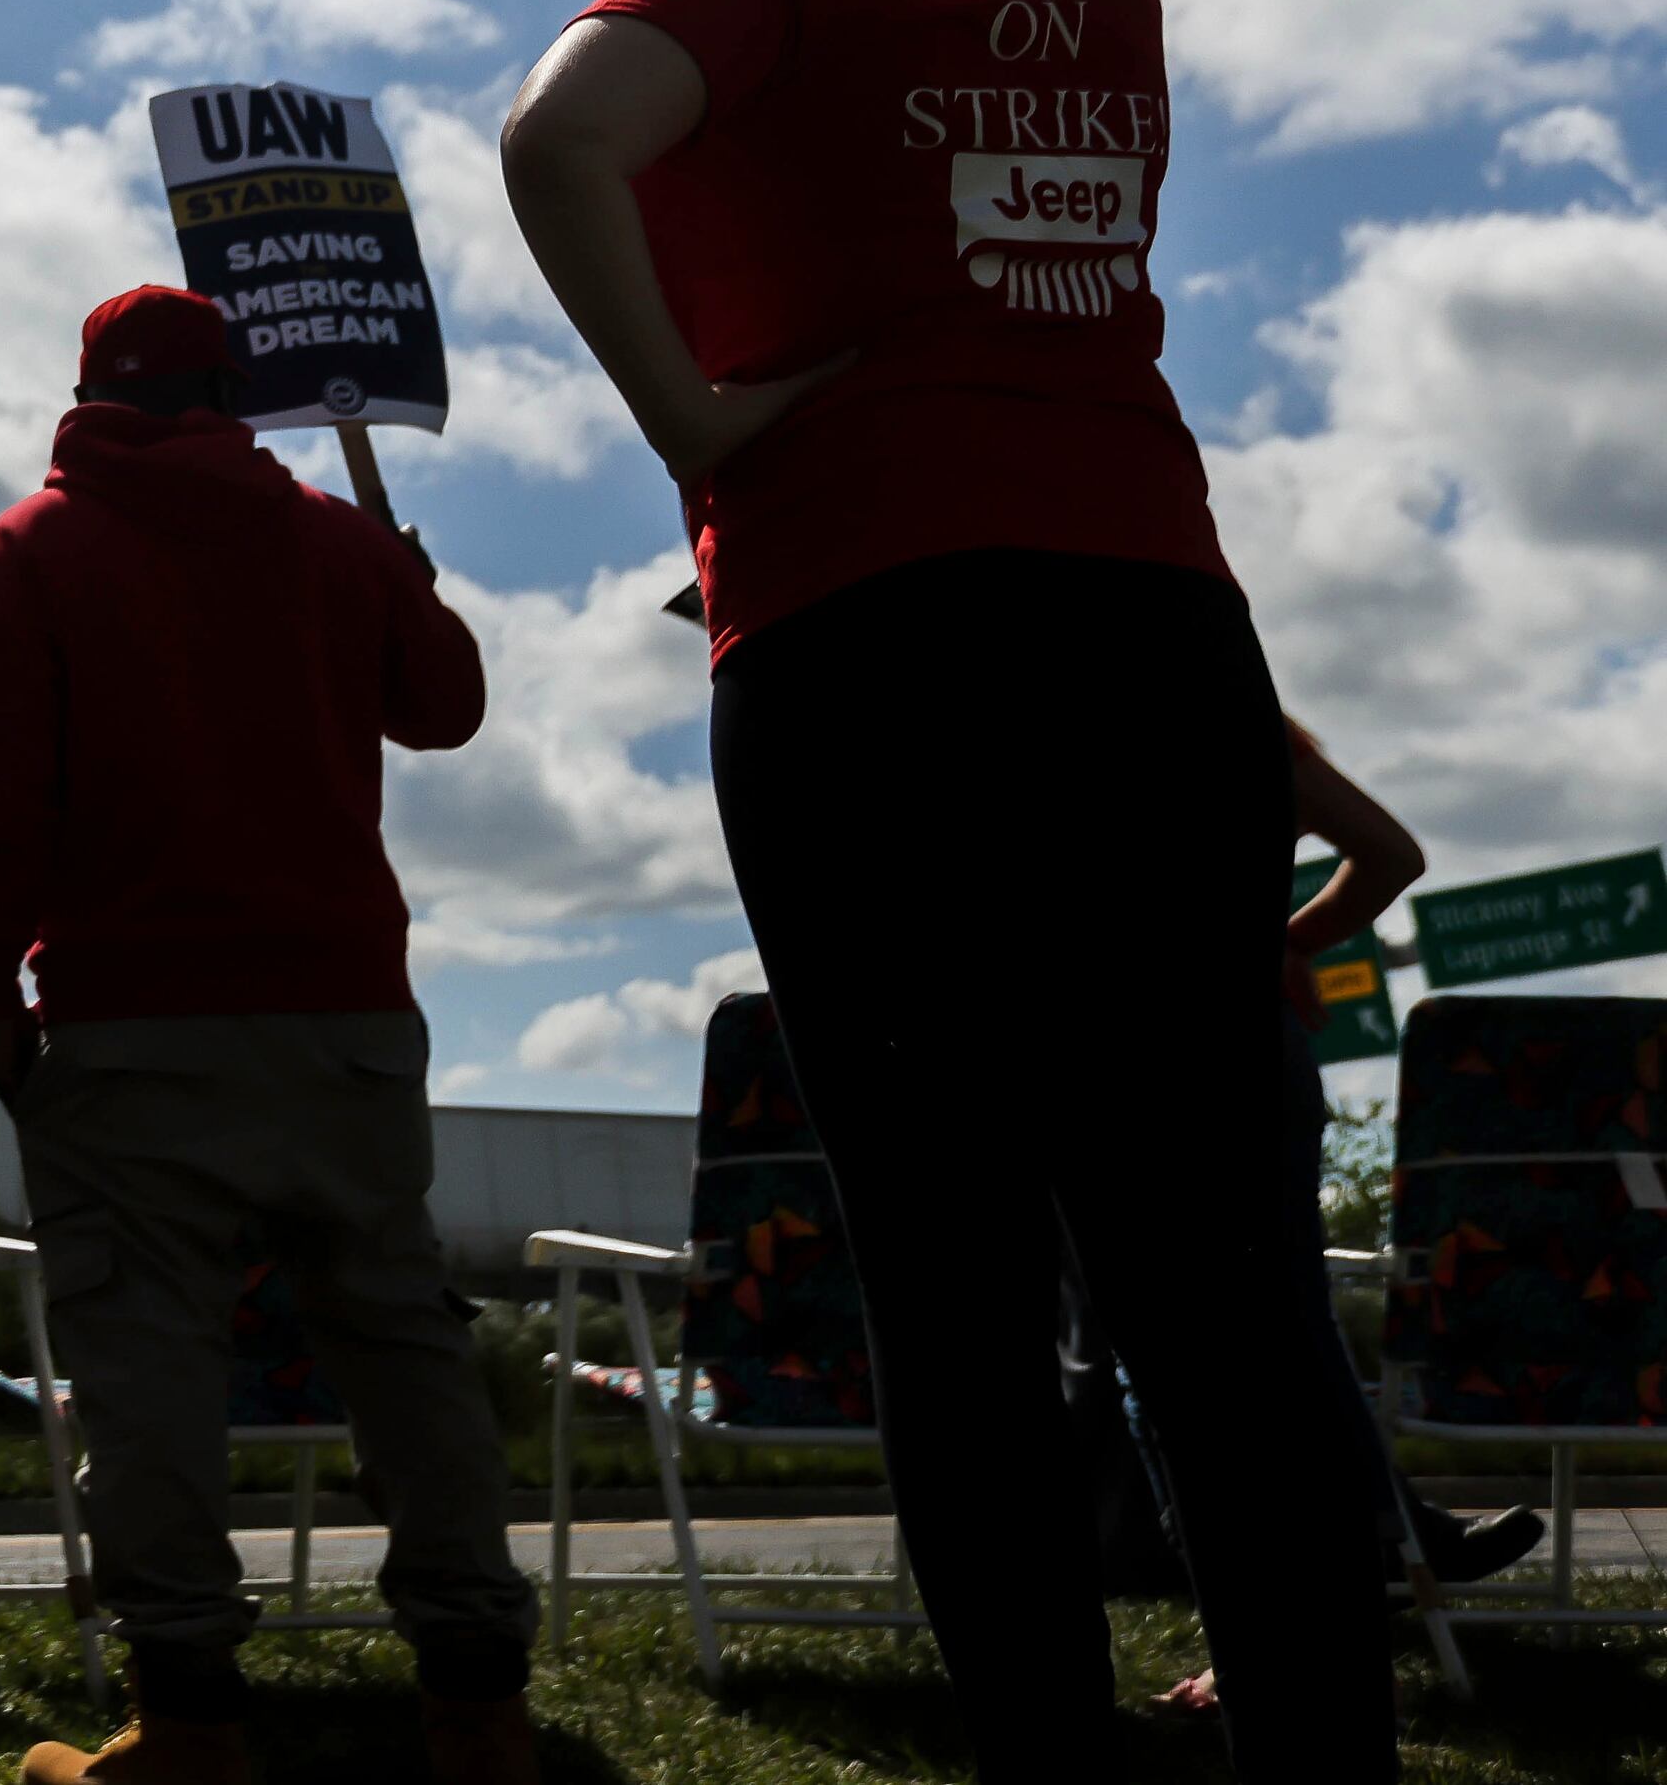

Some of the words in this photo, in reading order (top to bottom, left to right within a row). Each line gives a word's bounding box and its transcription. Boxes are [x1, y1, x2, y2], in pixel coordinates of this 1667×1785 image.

[989, 0, 1087, 62] ON
[192, 89, 349, 163] UAW
[903, 87, 1167, 157] STRIKE!
[186, 178, 330, 221] STAND
[341, 181, 392, 210] UP
[991, 166, 1122, 236] Jeep
[226, 233, 384, 272] SAVING
[211, 278, 425, 324] AMERICAN
[246, 315, 400, 357] DREAM
